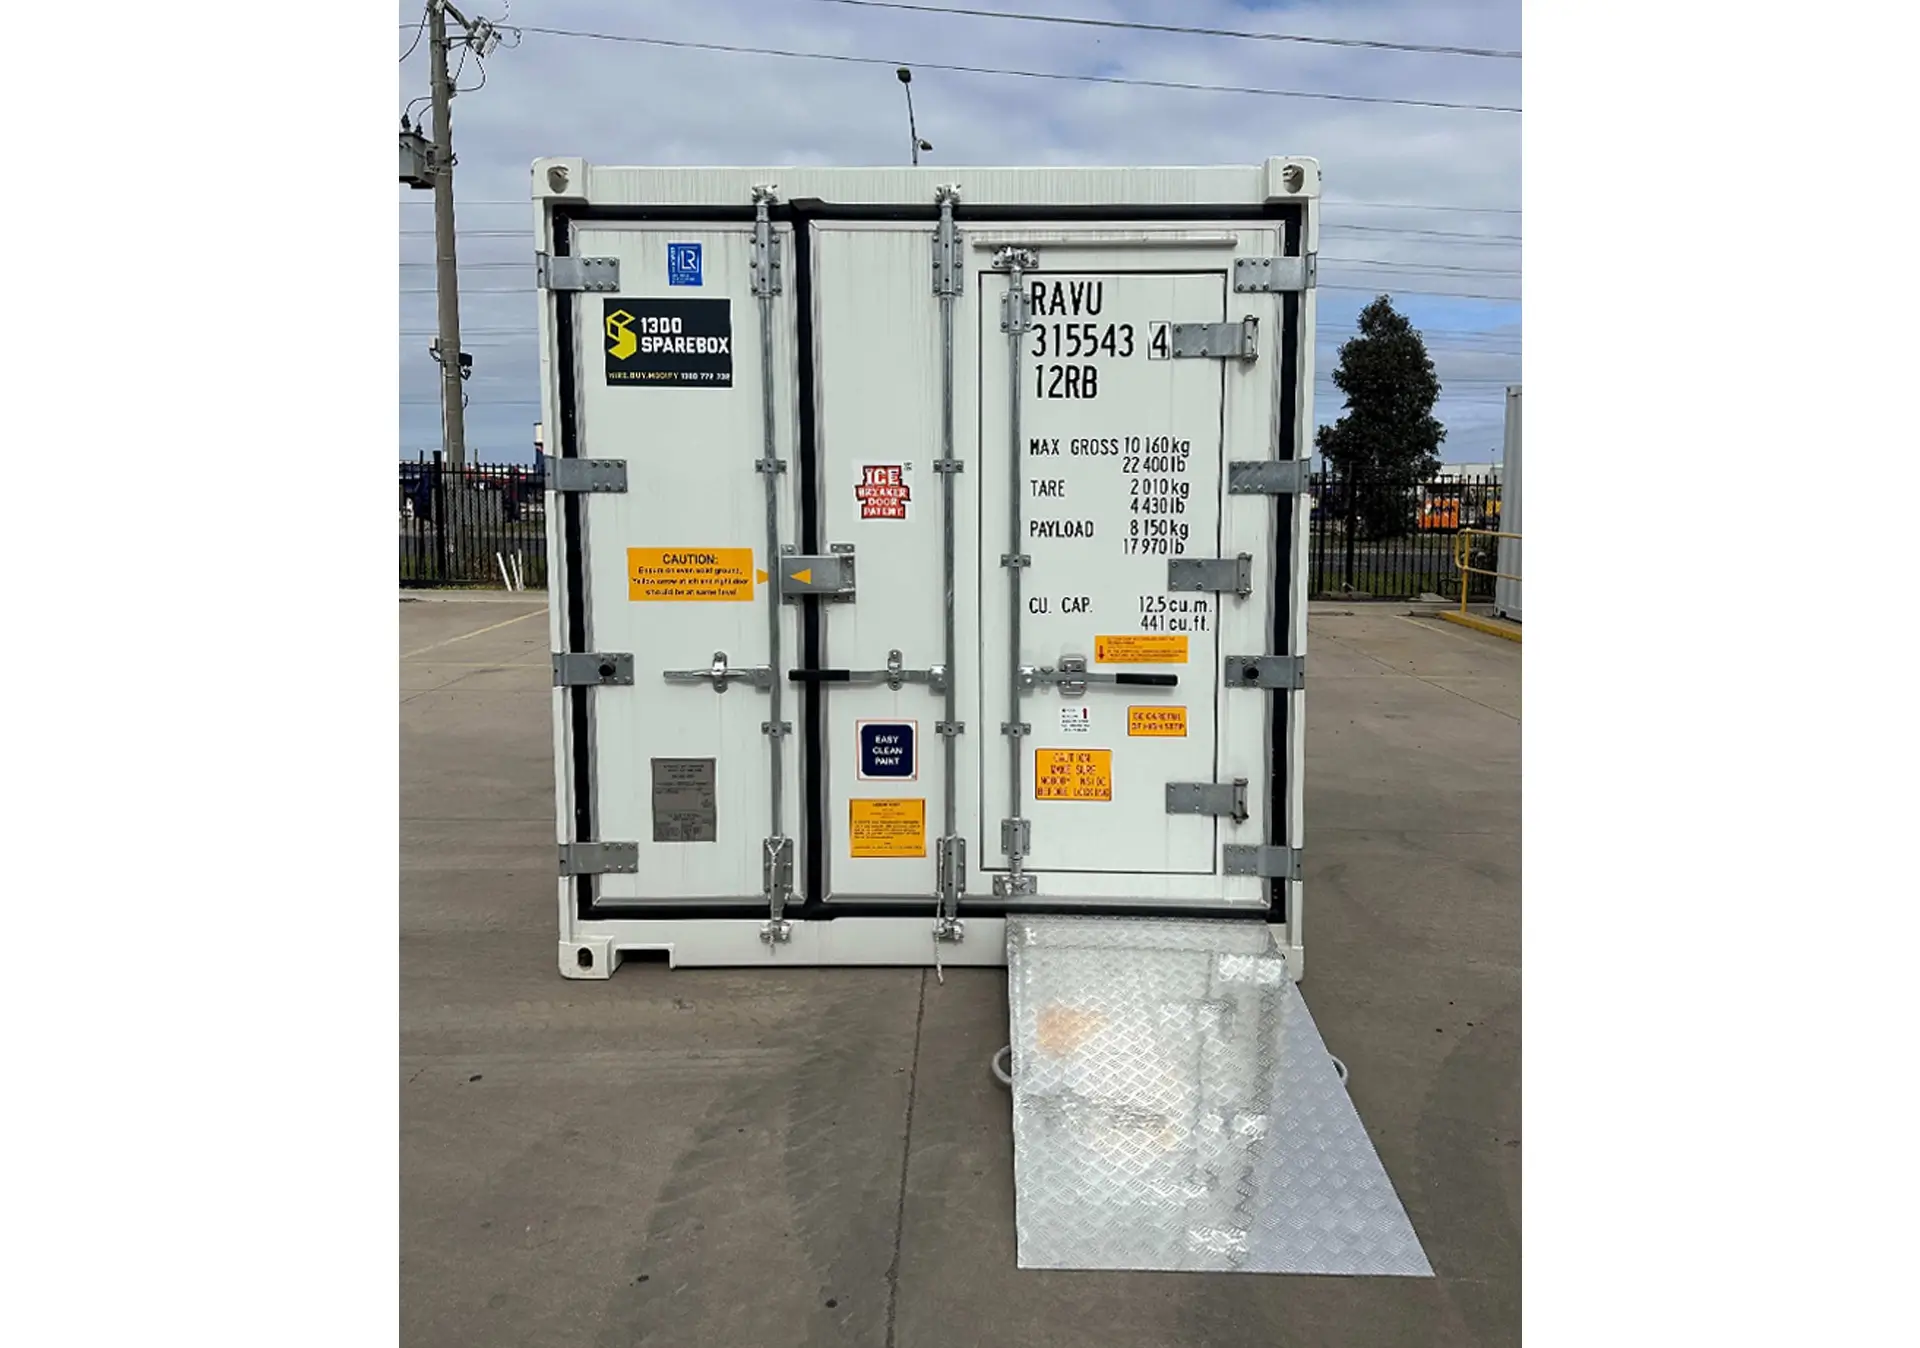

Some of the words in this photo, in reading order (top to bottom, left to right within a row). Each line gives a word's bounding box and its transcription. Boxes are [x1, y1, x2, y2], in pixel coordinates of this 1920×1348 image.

[1031, 281, 1102, 315] RAVU
[640, 317, 682, 334] 1300
[641, 336, 730, 354] SPAREBOX
[1031, 324, 1134, 357] 315543
[1152, 324, 1167, 357] 4
[1035, 365, 1098, 398] 12RB
[1030, 438, 1060, 456] MAX
[1070, 438, 1119, 456] GROSS
[865, 467, 899, 486] ICE
[857, 487, 908, 498] BREAKER
[1030, 480, 1065, 497] TARE
[867, 498, 898, 506] DOOR
[863, 506, 904, 517] PATENT
[1030, 520, 1094, 538] PAYLOAD
[662, 553, 719, 565] CAUTION:
[1029, 597, 1052, 614] CU.
[1061, 596, 1093, 613] CAP.
[874, 734, 900, 745] EASY
[872, 745, 904, 755] CLEAN
[874, 756, 901, 766] PAINT
[1078, 776, 1106, 787] NSIDE
